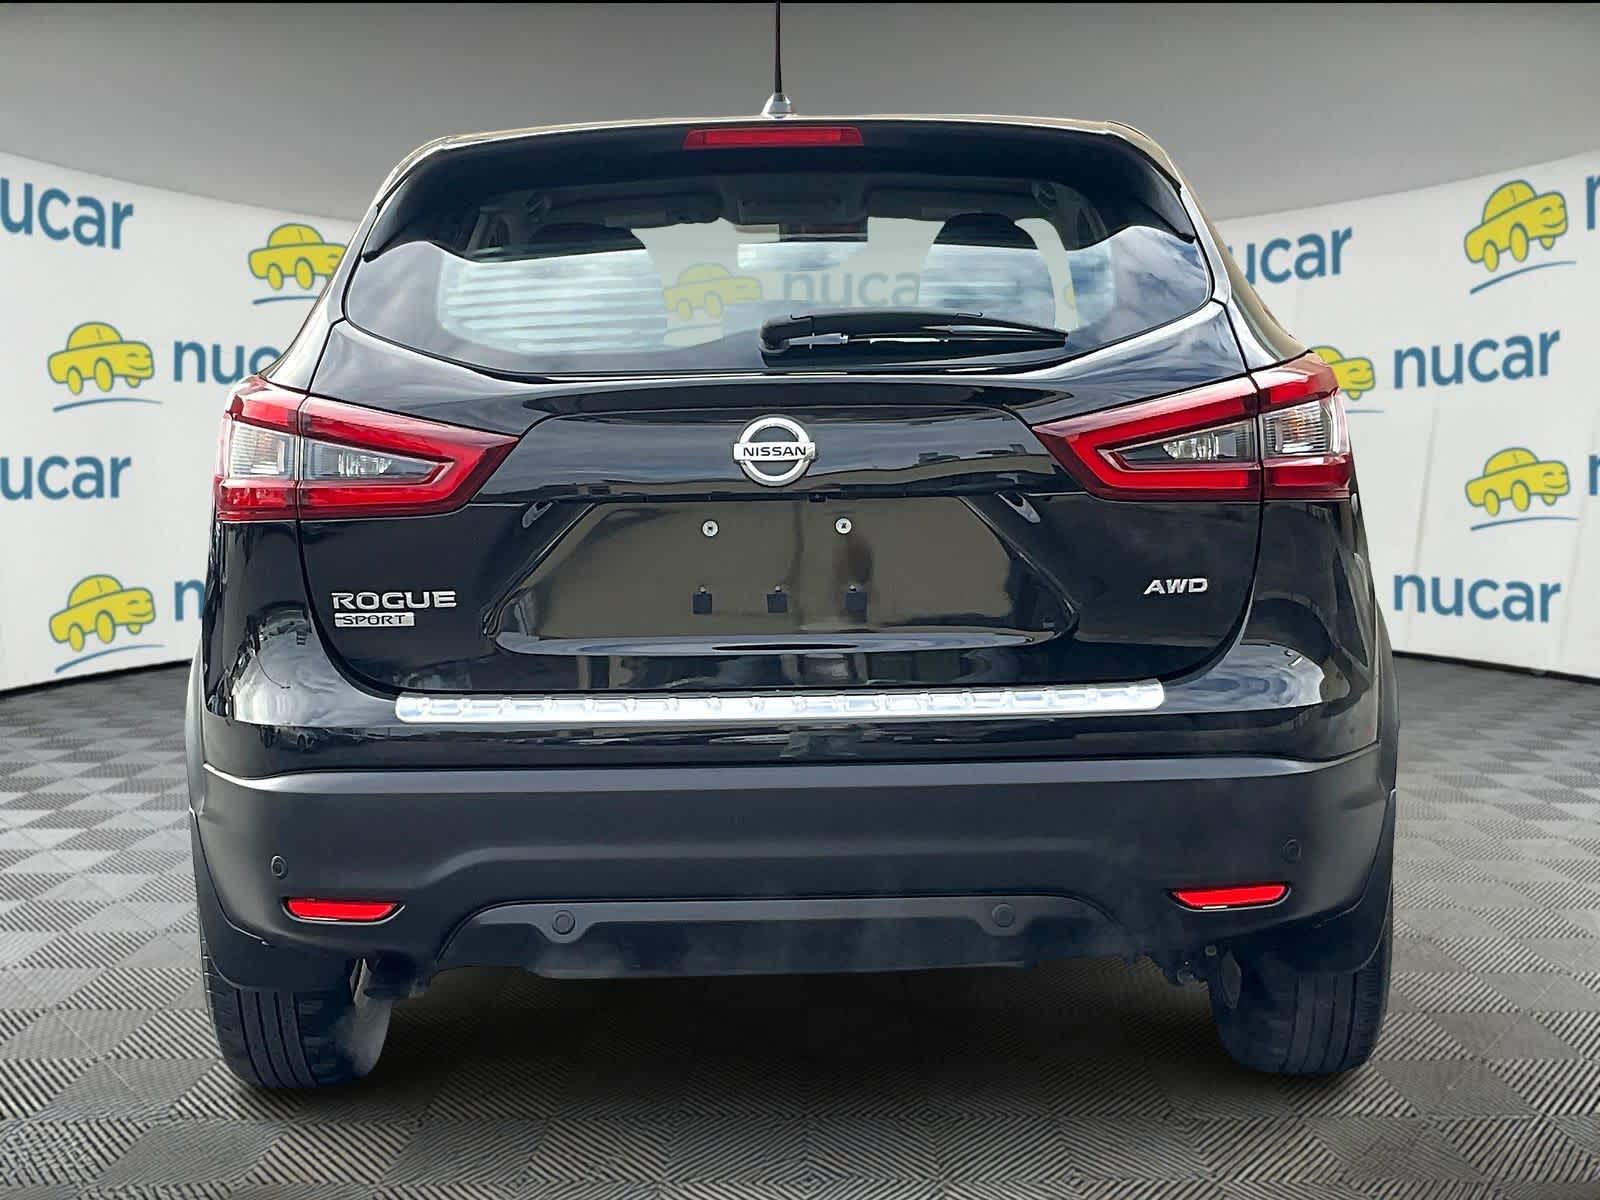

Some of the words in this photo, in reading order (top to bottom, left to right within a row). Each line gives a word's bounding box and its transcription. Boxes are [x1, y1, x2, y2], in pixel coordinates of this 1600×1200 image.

[0, 178, 134, 249] ucar
[1394, 330, 1560, 389] nucar
[743, 446, 807, 457] NISSAN
[0, 455, 131, 500] ucar
[331, 590, 457, 610] ROGUE
[1143, 577, 1208, 595] AWD
[1394, 574, 1561, 623] nucar
[343, 615, 405, 625] SPORT
